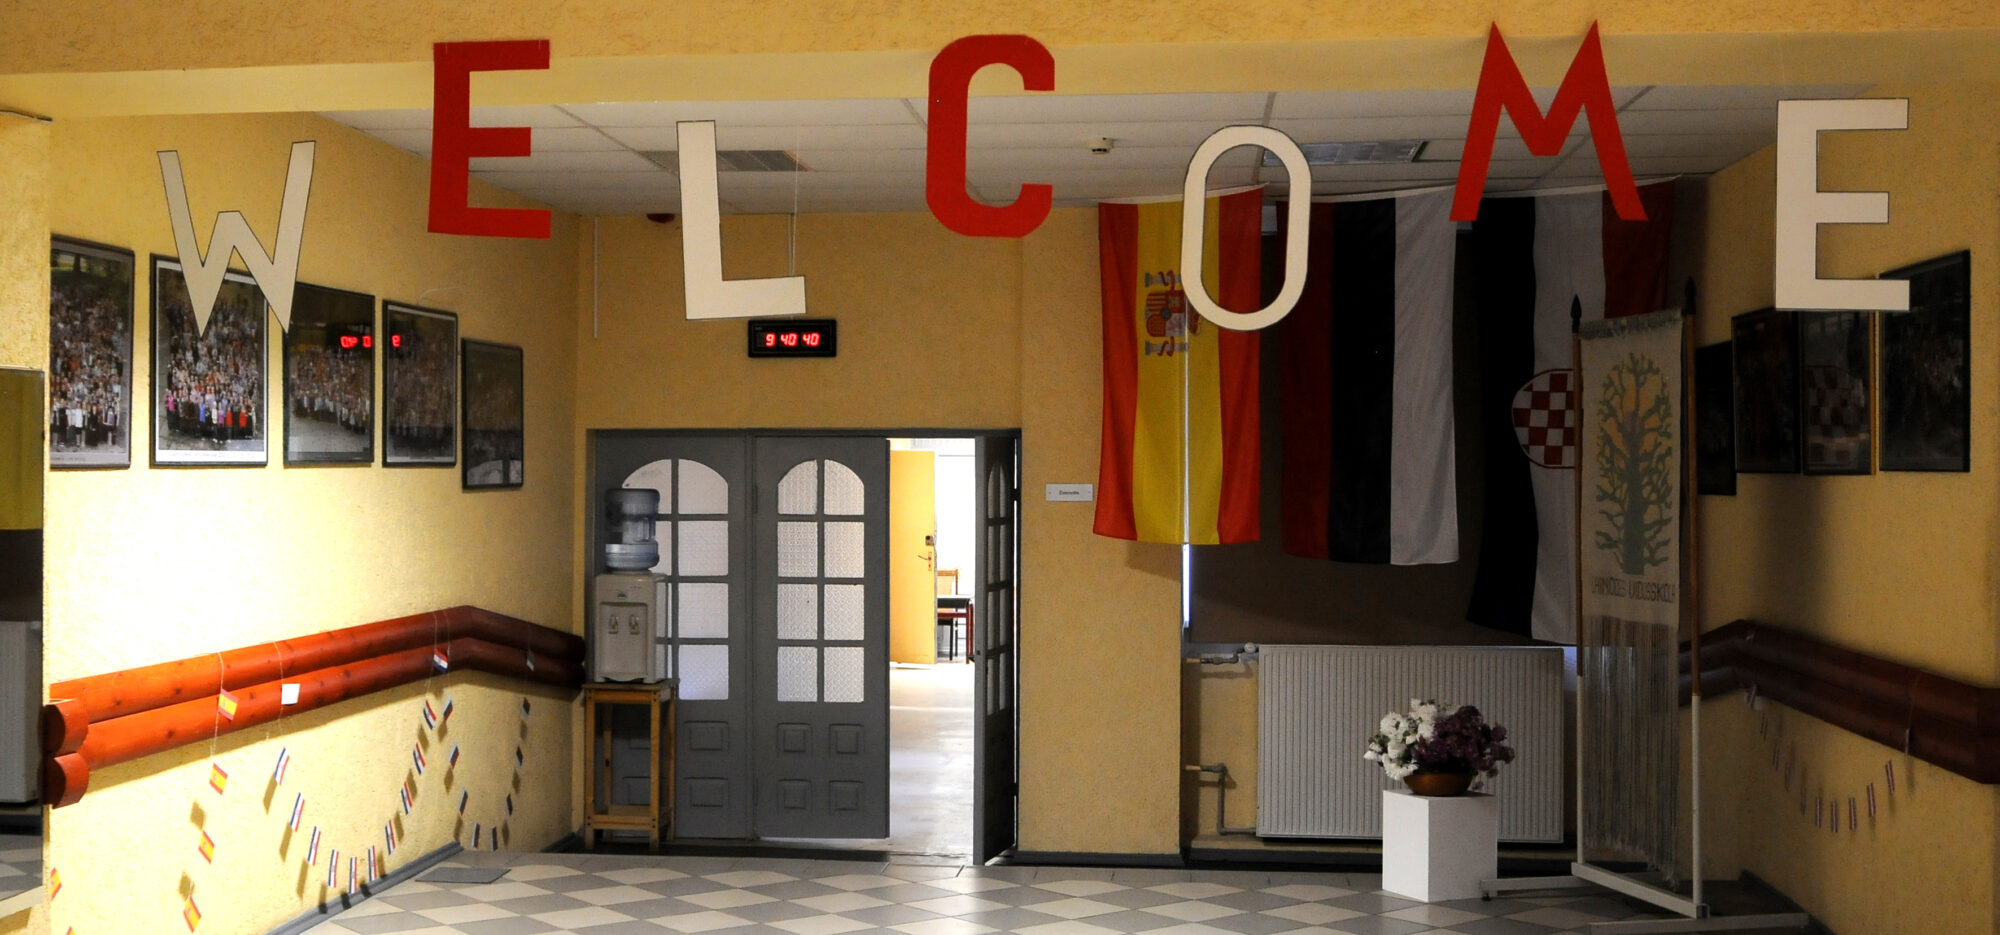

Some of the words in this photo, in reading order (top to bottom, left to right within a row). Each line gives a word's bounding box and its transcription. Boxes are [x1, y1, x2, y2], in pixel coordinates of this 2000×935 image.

[157, 20, 1910, 337] WELCOME
[765, 332, 776, 347] 9
[780, 332, 798, 347] 40
[802, 332, 820, 347] 40
